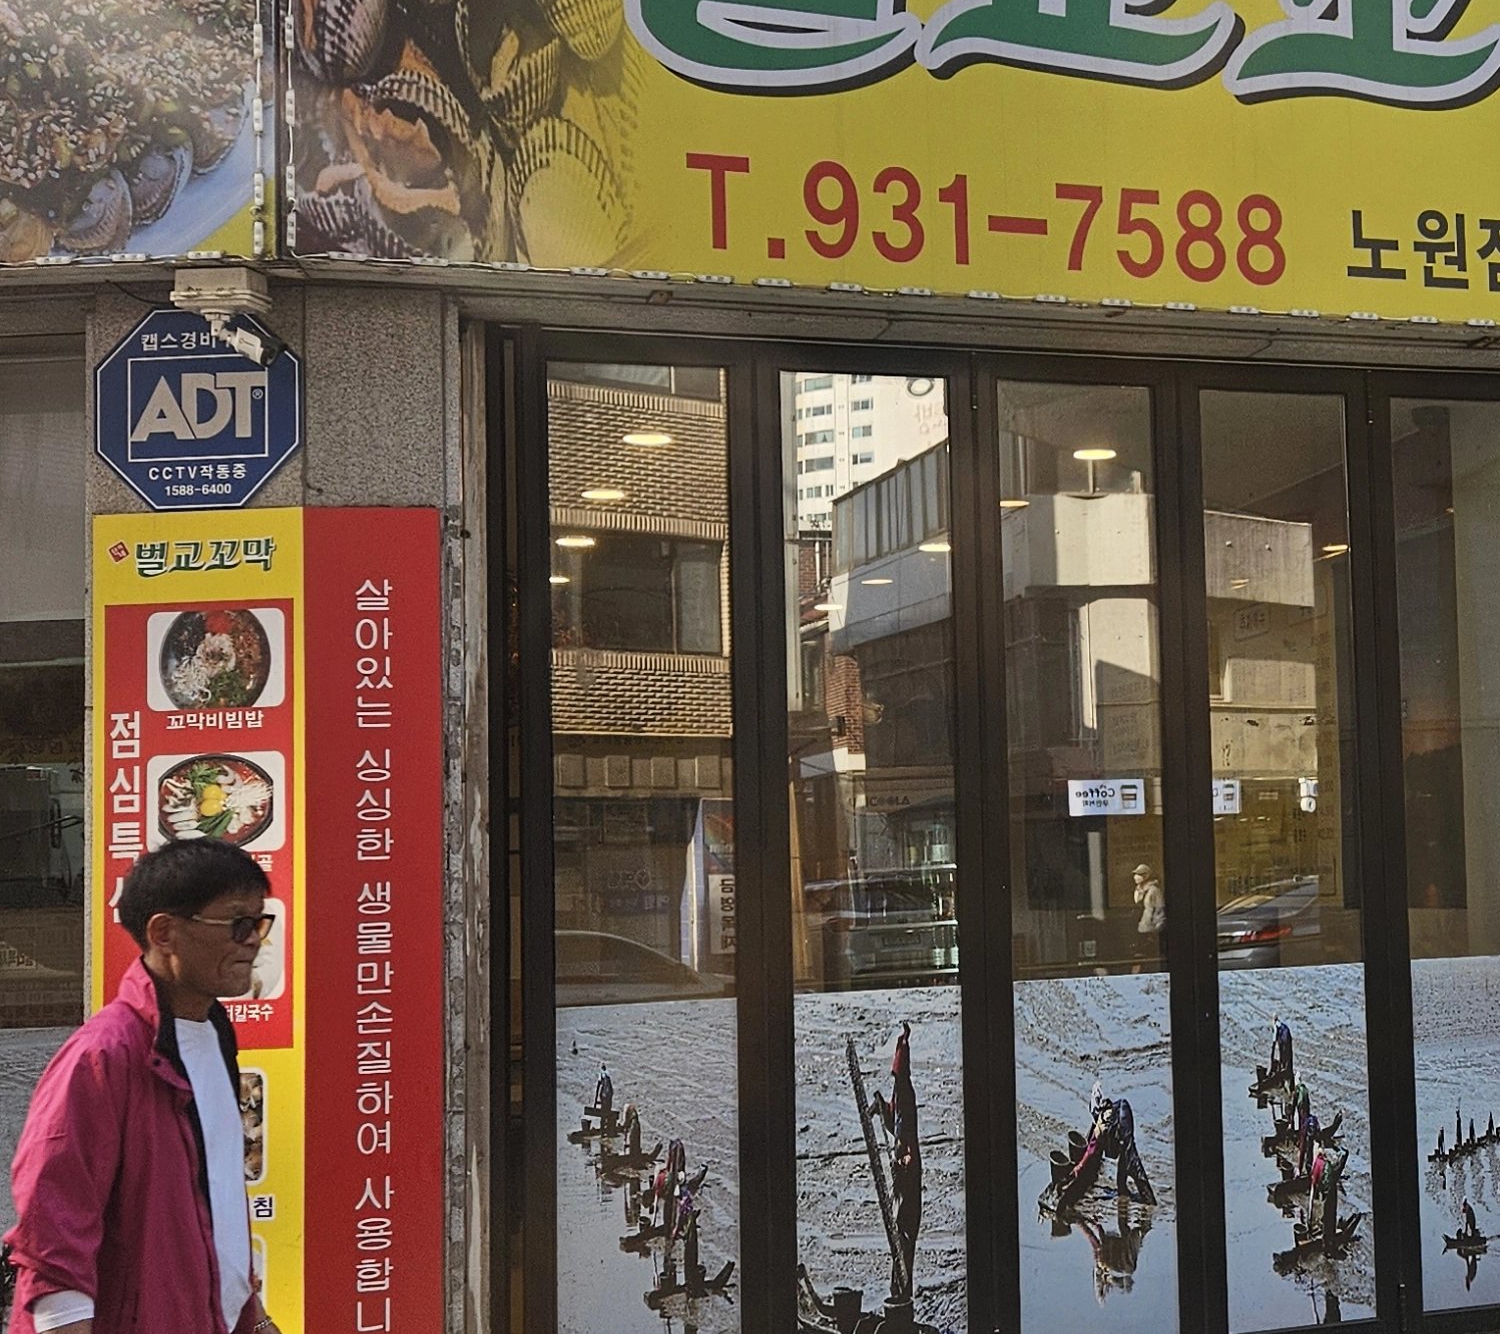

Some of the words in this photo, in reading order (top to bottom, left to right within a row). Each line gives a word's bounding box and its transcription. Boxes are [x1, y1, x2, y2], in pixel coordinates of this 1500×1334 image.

[686, 153, 1287, 287] T.931-7588
[141, 332, 233, 352] 캡스경비
[130, 371, 267, 443] ADT
[148, 464, 247, 481] CCTV작동중
[164, 482, 232, 496] 1588-6400
[135, 536, 277, 578] 벌교꼬막
[355, 578, 394, 729] 살아있는
[166, 710, 265, 730] 꼬막비빔밥
[355, 748, 394, 863] 싱싱한
